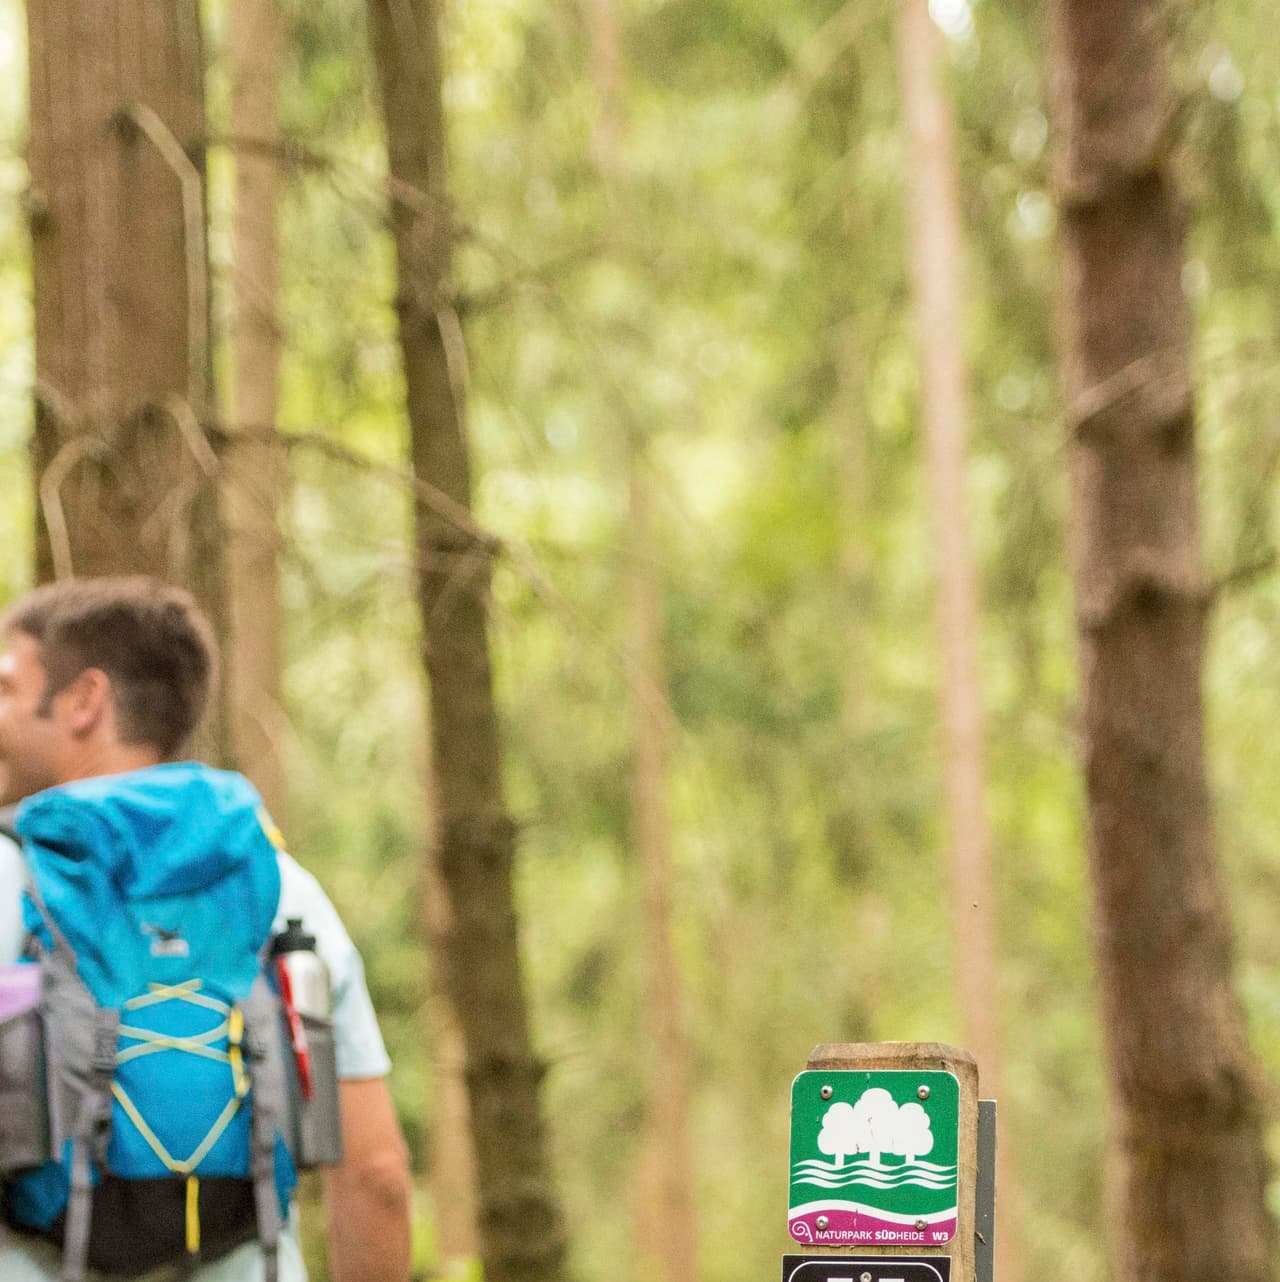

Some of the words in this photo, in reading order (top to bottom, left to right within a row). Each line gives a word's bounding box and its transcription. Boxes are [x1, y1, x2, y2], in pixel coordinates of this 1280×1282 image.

[816, 1230, 872, 1240] NATURPARK
[875, 1229, 924, 1241] SÜDHEIDE
[932, 1231, 949, 1241] W3
